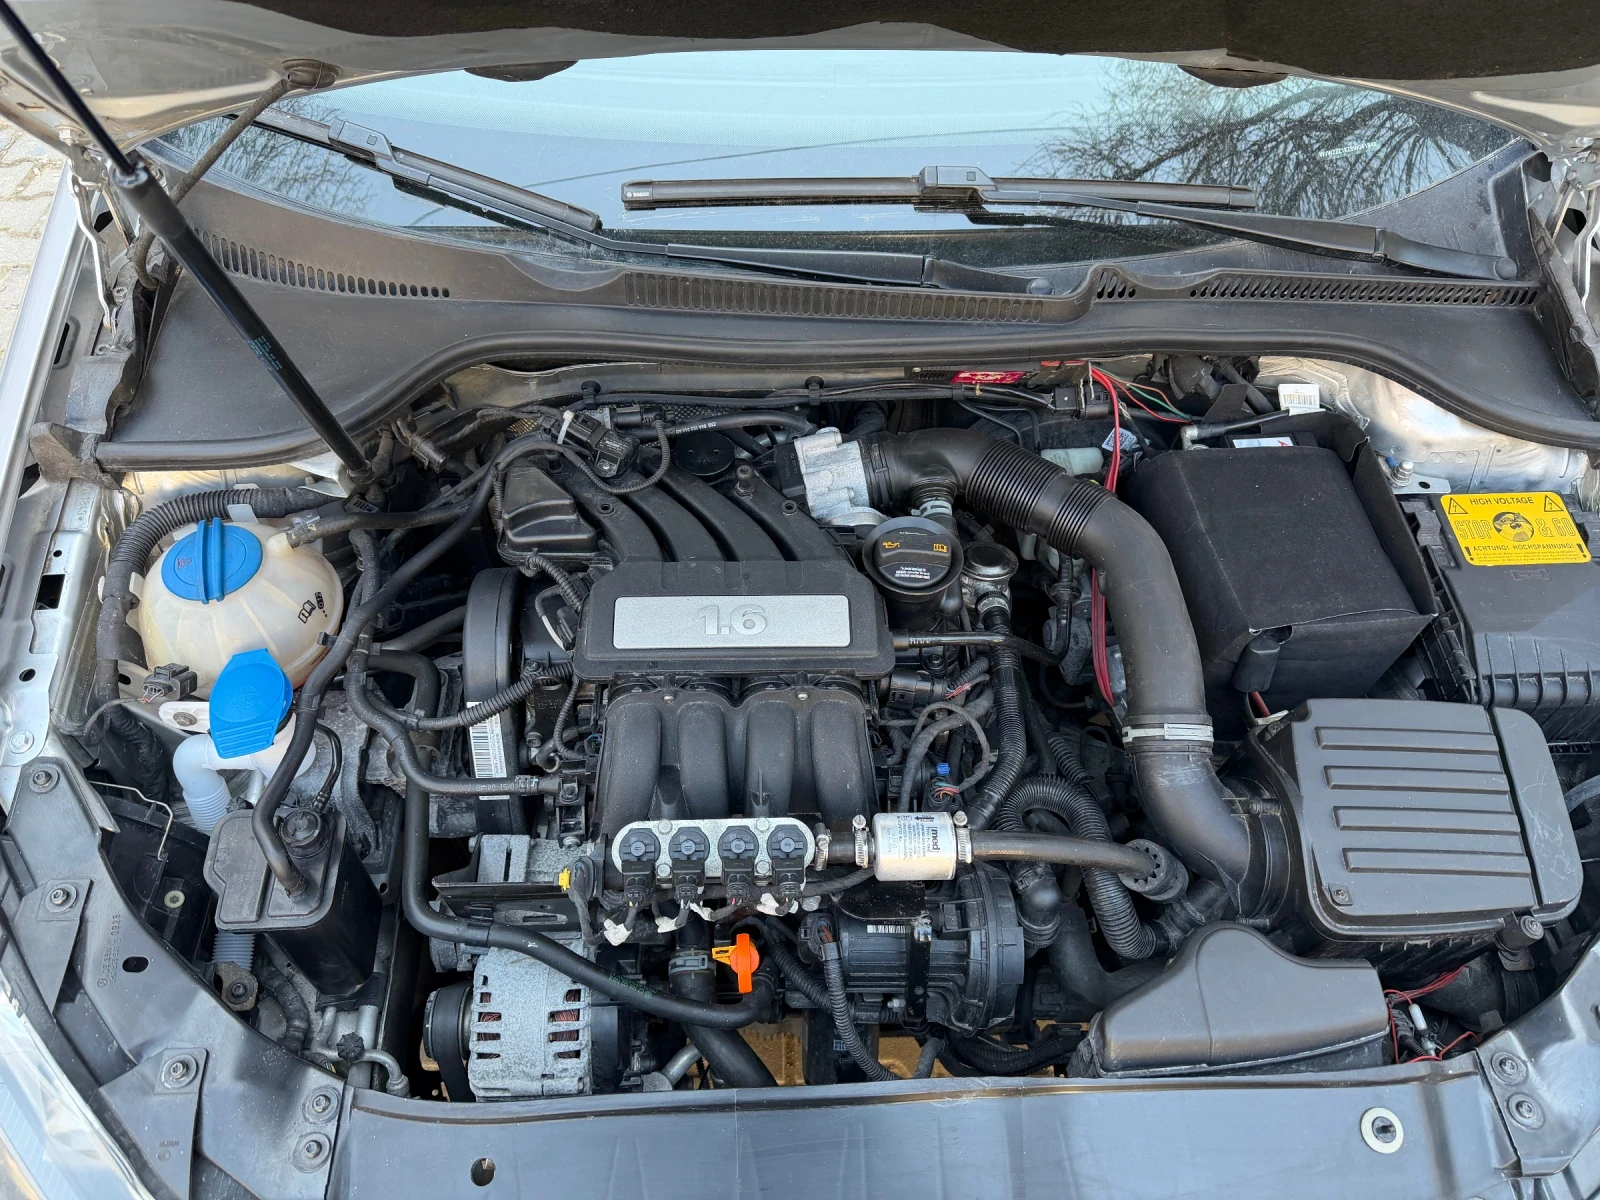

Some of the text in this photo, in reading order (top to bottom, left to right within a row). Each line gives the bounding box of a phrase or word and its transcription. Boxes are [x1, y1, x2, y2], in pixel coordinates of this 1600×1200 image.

[1454, 519, 1493, 539] STOP
[1552, 517, 1577, 537] GO
[1473, 543, 1575, 552] ACHTUNG! HOCHSPANNUNG!
[699, 604, 767, 636] 1.6
